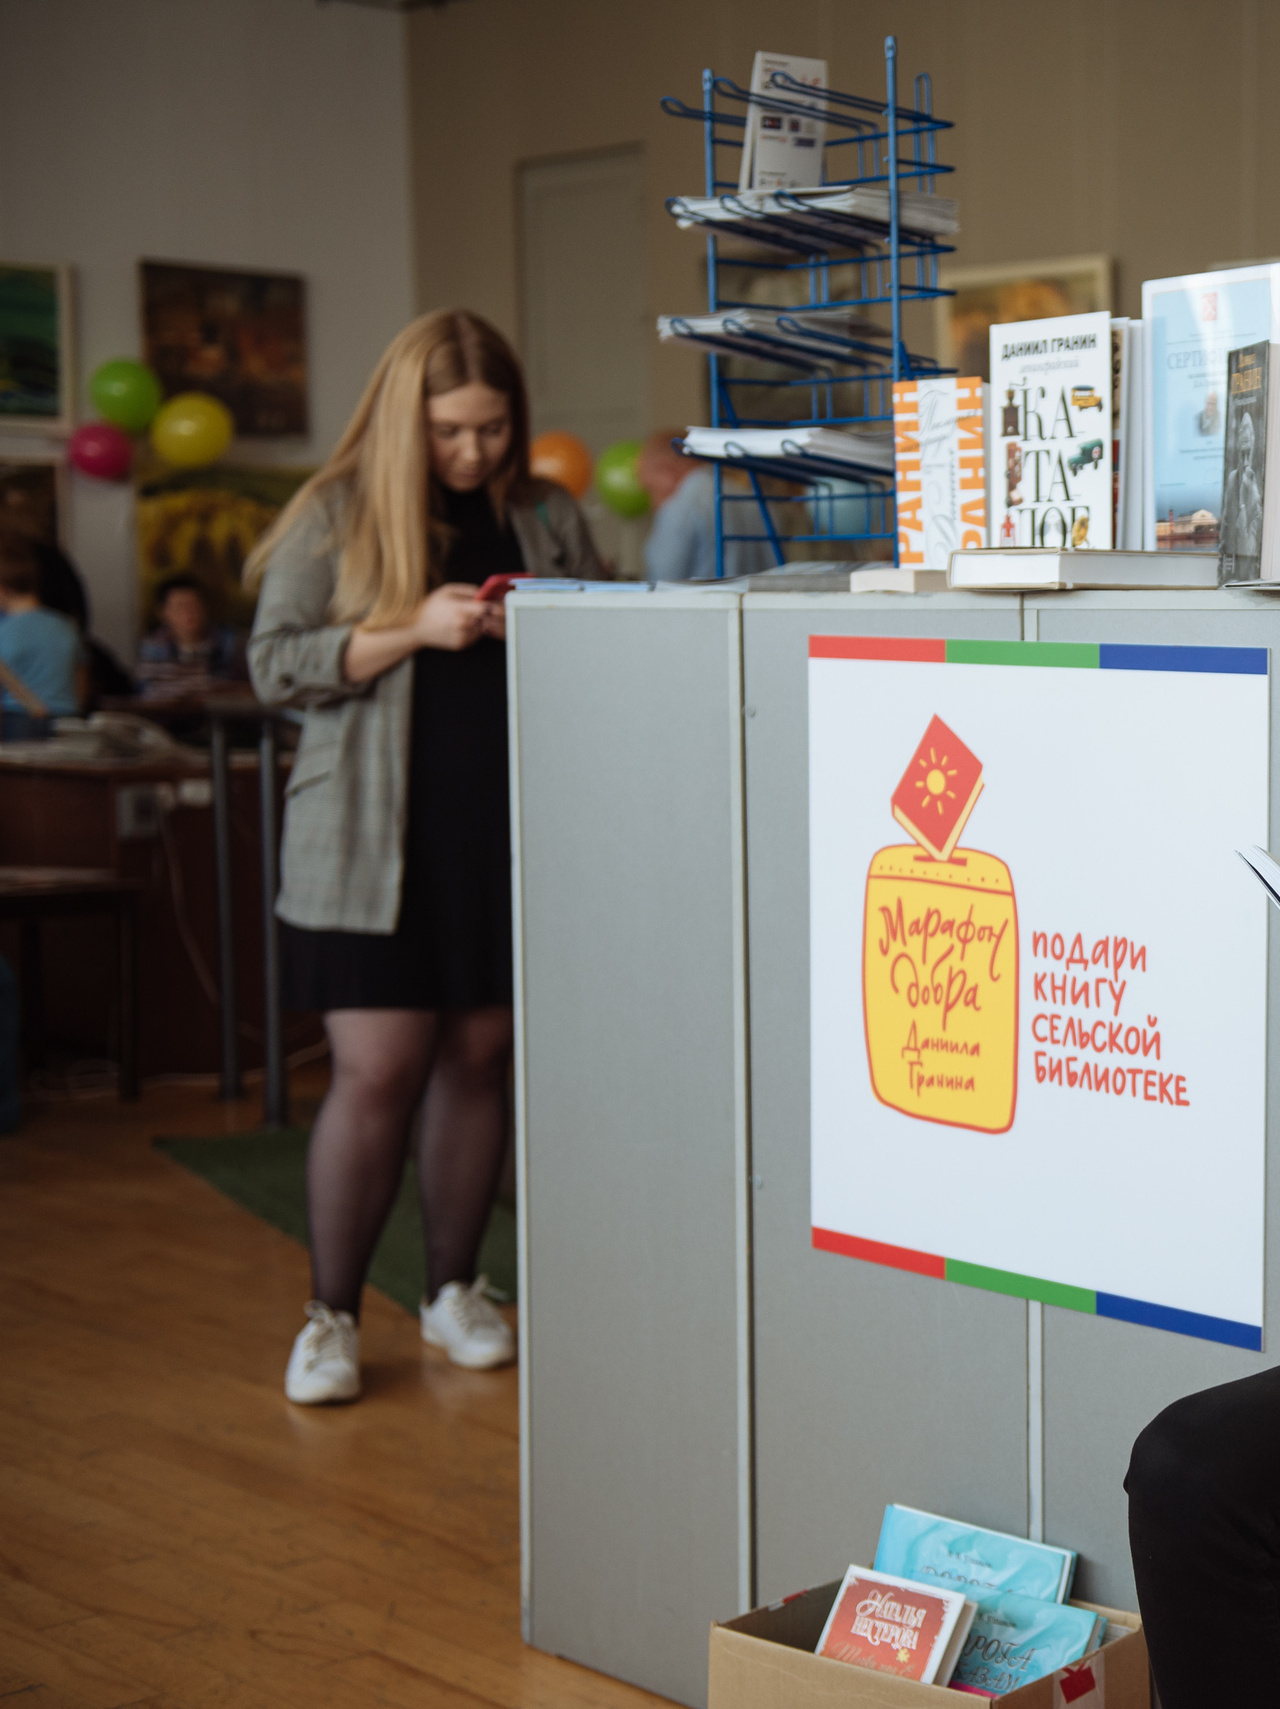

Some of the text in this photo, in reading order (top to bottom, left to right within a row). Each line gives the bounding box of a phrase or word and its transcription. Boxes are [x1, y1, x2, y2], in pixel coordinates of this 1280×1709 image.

[1001, 333, 1096, 361] ДАНИИЛ ГРАНИН
[878, 896, 1009, 982] Марафон
[890, 943, 982, 1032] добра
[1034, 972, 1127, 1017] КНИГУ
[901, 1019, 980, 1059] Даниила
[1032, 1013, 1161, 1061] СЕЛЬСКОЙ
[907, 1061, 975, 1097] Гранина
[1034, 1051, 1190, 1106] БИБЛИОТЕКЕ
[850, 1615, 920, 1650] НЕСТЕРОВА
